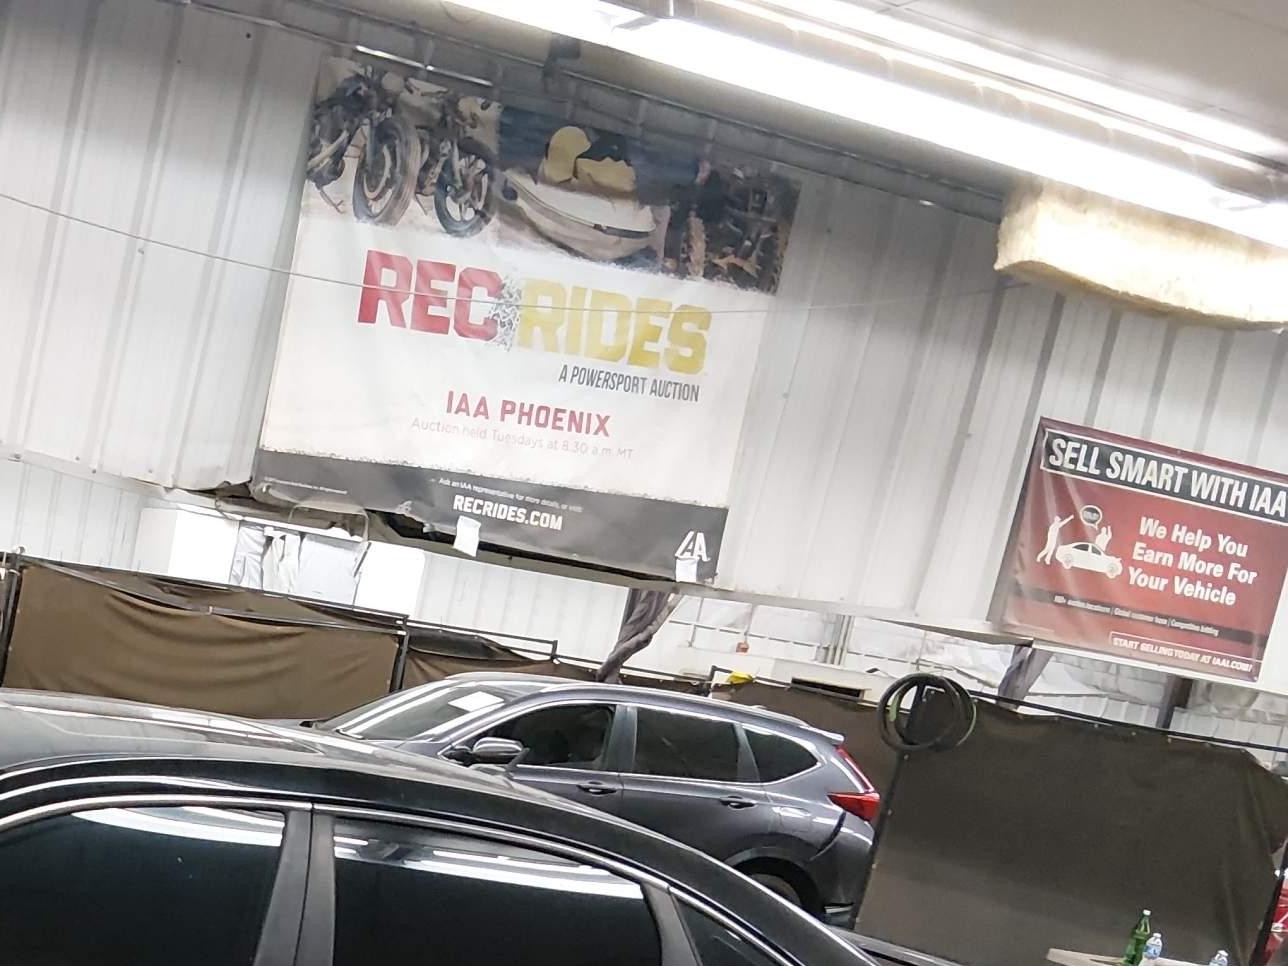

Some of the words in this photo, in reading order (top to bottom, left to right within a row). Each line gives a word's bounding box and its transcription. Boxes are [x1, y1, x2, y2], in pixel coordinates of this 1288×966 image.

[357, 249, 506, 342] REC
[517, 277, 712, 376] RIDES
[558, 364, 569, 383] A
[570, 366, 648, 396] POWERSPORT
[650, 379, 699, 403] AUCTION
[411, 416, 459, 435] Auction
[492, 429, 544, 449] Tuesdays
[446, 390, 490, 420] IAA
[499, 399, 611, 438] PHOENIX
[1049, 437, 1101, 476] SELL
[1106, 451, 1188, 494] SMART
[1191, 470, 1248, 508] WITH
[1249, 484, 1287, 518] IAA
[453, 494, 564, 531] RECRIDES.COM
[1139, 516, 1168, 539] We
[1171, 523, 1212, 553] Help
[1217, 533, 1249, 558] You
[1132, 541, 1174, 568] Earn
[1178, 551, 1225, 578] More
[1227, 562, 1258, 585] For
[1128, 566, 1169, 592] Your
[1173, 575, 1237, 606] Vehicle
